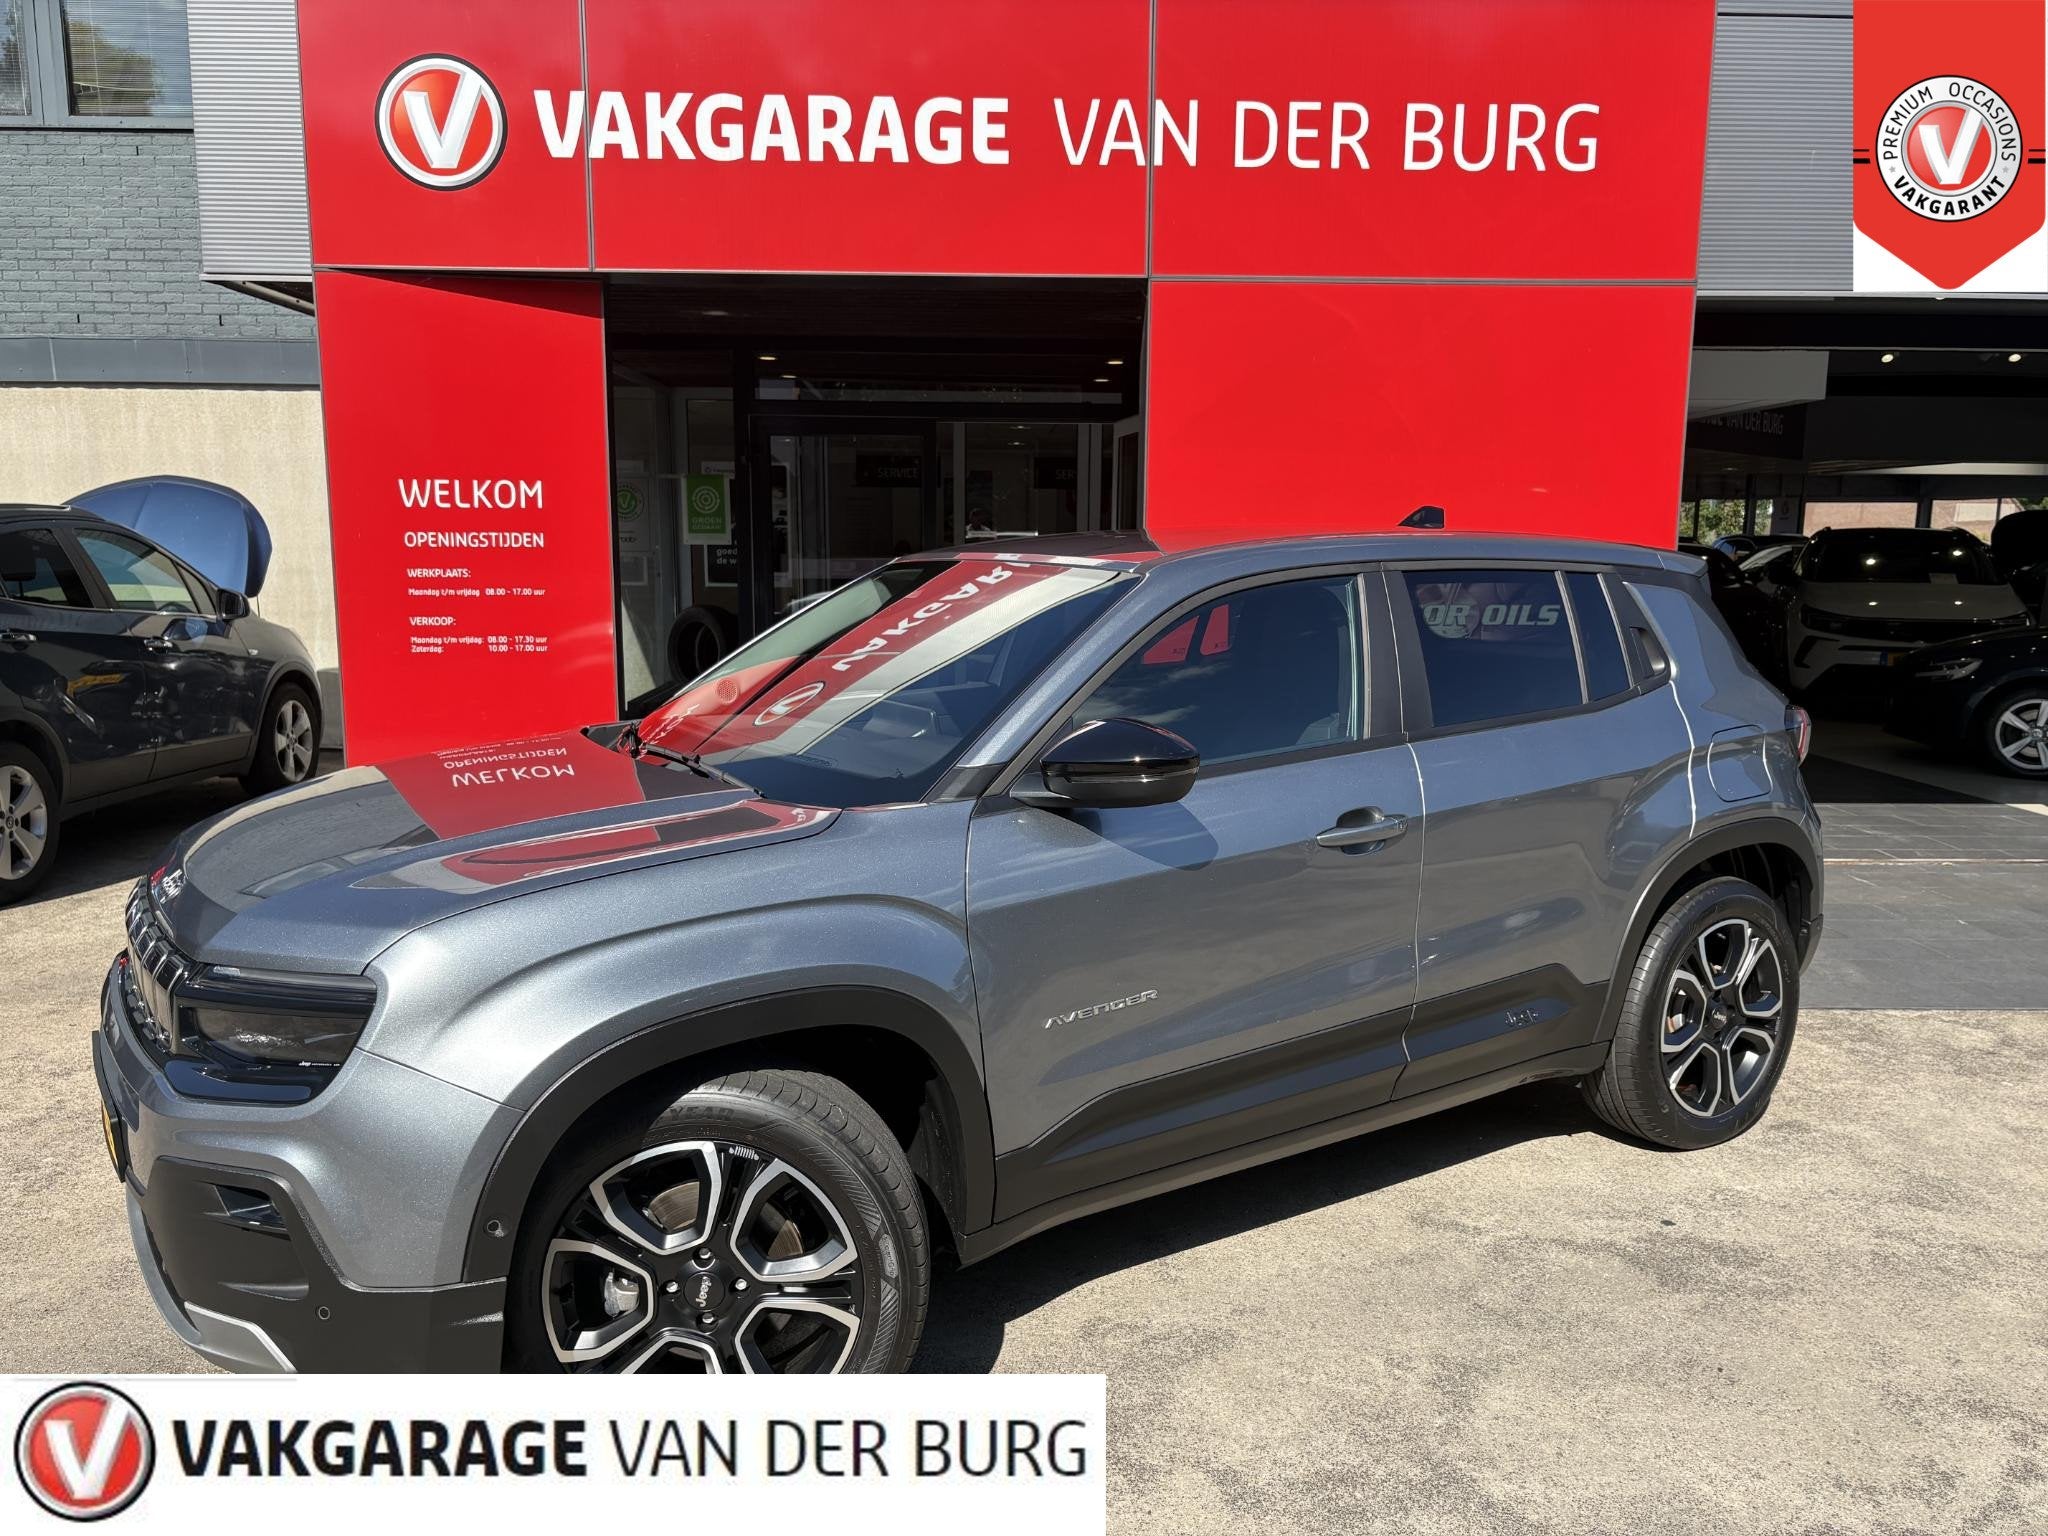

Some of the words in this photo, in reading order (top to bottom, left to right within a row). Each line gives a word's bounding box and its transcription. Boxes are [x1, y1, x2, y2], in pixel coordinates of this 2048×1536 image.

[403, 68, 484, 169] V
[533, 89, 1010, 166] VAKGARAGE
[1053, 97, 1199, 168] VAN
[1234, 100, 1371, 170] DER
[1402, 102, 1600, 173] BURG
[1762, 412, 1784, 435] BURG
[877, 467, 920, 479] SERVICE
[1055, 468, 1078, 480] SER
[398, 479, 543, 509] WELKOM
[404, 531, 544, 548] OPENINGSTIJDEN
[406, 568, 471, 578] WERKPLAATS:
[408, 587, 440, 597] Maandag
[441, 588, 455, 596] t/m
[456, 588, 480, 597] vrijdag
[485, 588, 506, 596] 08.00
[512, 588, 532, 596] 17.00
[409, 616, 456, 626] VERKOOP:
[1480, 604, 1561, 626] OILS
[411, 636, 442, 645] Maandag
[443, 636, 457, 644] t/m
[411, 645, 444, 654] Zaterdag:
[1045, 989, 1159, 1029] AVENGER
[695, 1276, 713, 1308] Jeep
